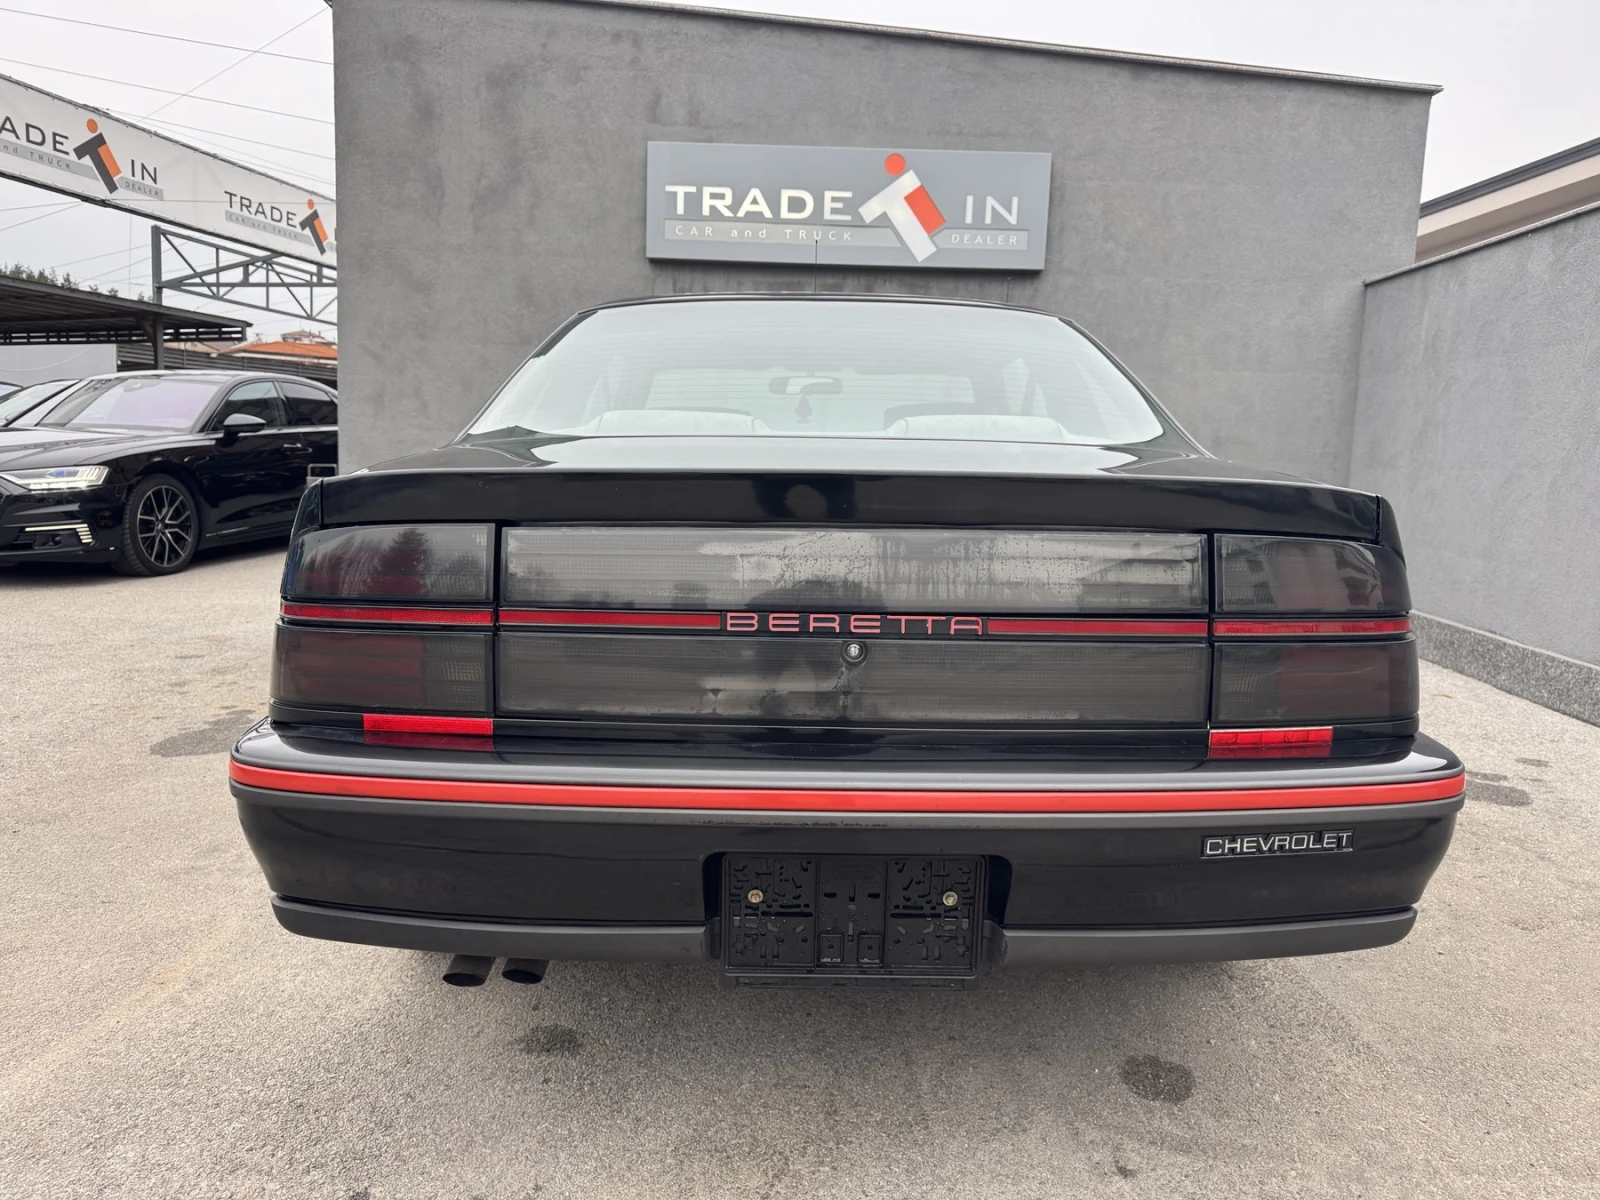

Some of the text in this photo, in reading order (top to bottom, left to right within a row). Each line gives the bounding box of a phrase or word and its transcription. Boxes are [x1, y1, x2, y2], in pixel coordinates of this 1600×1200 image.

[28, 151, 71, 170] TRUCK
[125, 181, 159, 196] DEALER
[131, 159, 157, 185] IN
[224, 190, 297, 229] TRADE
[665, 184, 853, 221] TRADE
[965, 195, 1019, 225] IN
[675, 225, 1018, 246] CAR and TRUCK DEALER
[726, 612, 983, 636] BERETTA
[1204, 832, 1353, 857] CHEVROLET
